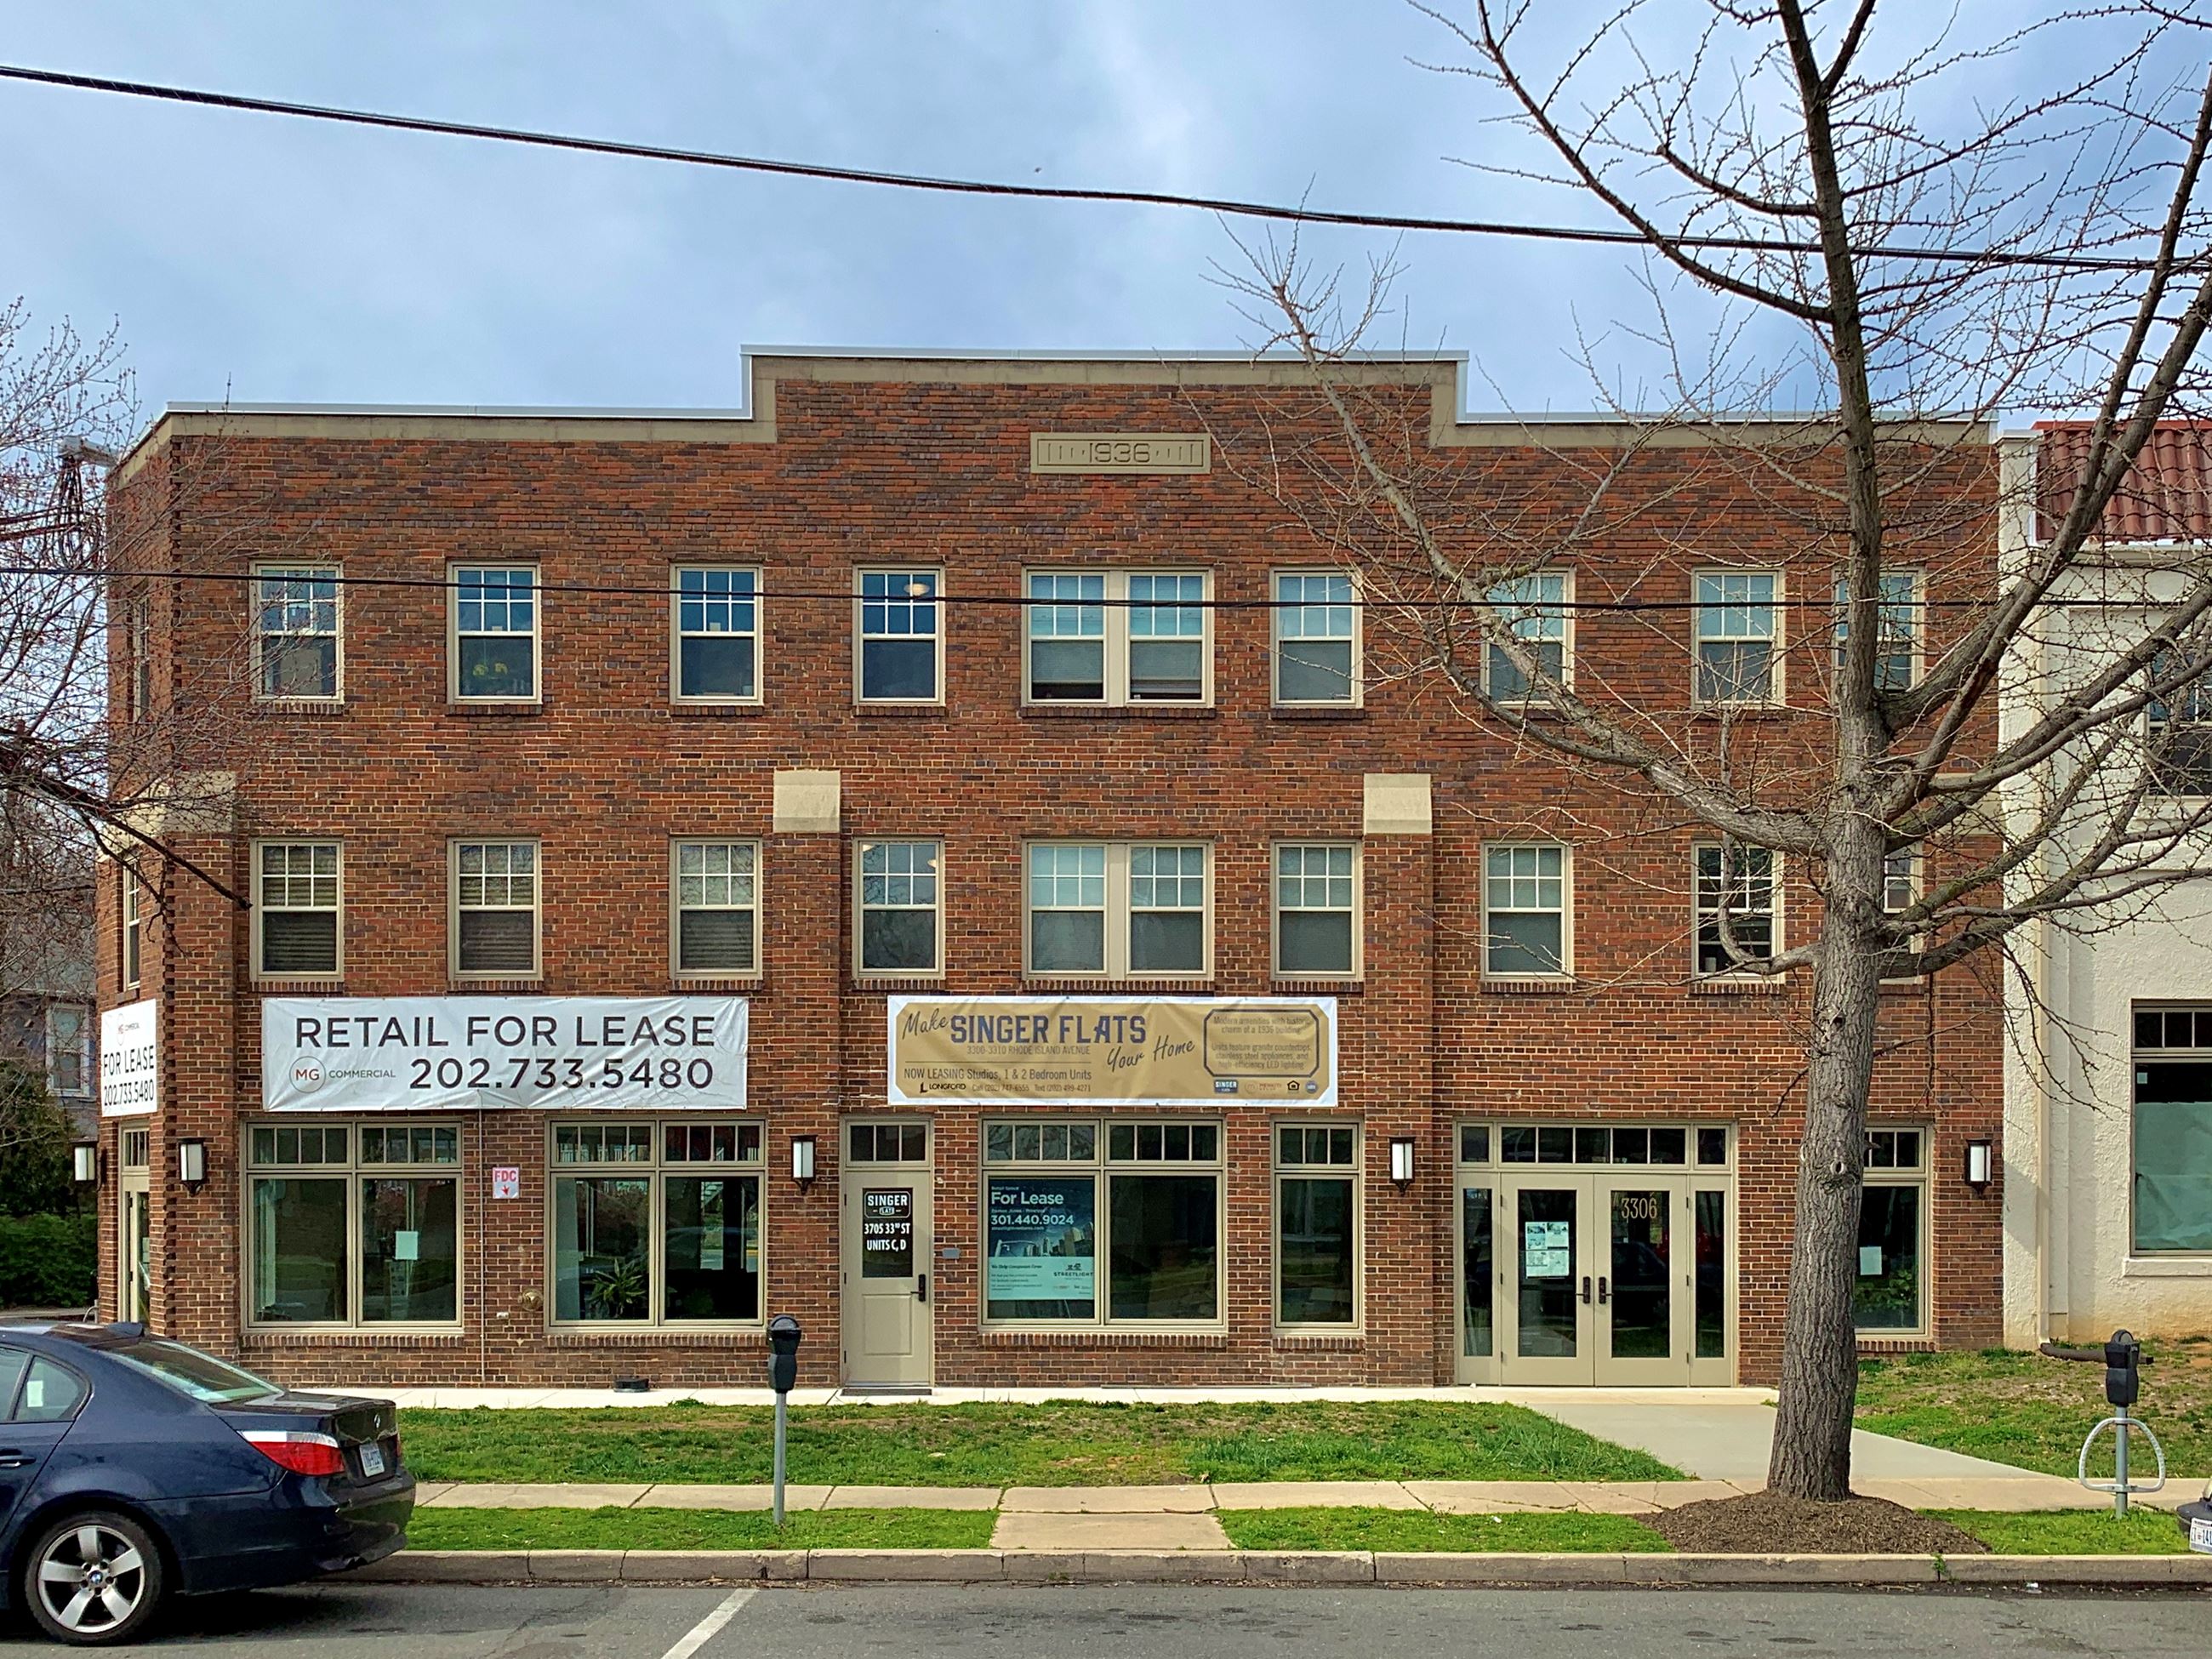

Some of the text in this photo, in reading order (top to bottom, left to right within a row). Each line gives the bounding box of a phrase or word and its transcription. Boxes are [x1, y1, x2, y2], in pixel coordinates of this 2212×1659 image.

[1089, 442, 1151, 464] 1936
[296, 1016, 715, 1048] RETAIL FOR LEASE
[902, 1007, 949, 1040] Make
[950, 1015, 1146, 1043] SINGER FLATS
[1008, 1045, 1033, 1055] RHODE
[1035, 1045, 1061, 1055] ISLAND
[1062, 1045, 1092, 1055] AVENUE
[1107, 1035, 1195, 1073] Your Home
[103, 1045, 155, 1077] FOR LEASE
[295, 1068, 396, 1081] MG COMMERCIAL
[409, 1058, 714, 1090] 202.733.5480
[904, 1068, 1092, 1081] NOW LEASING Studios, 1 & 2 Bedroom Units
[103, 1078, 155, 1107] 202.733.5480
[1345, 1170, 1368, 1183] FDC
[868, 1194, 908, 1206] SINGER
[991, 1191, 1064, 1205] For Lease
[1621, 1197, 1657, 1219] 3306
[864, 1223, 884, 1234] 3705
[900, 1223, 911, 1234] ST
[990, 1214, 1075, 1225] 301.440.9024
[866, 1239, 907, 1252] UNITS C, D
